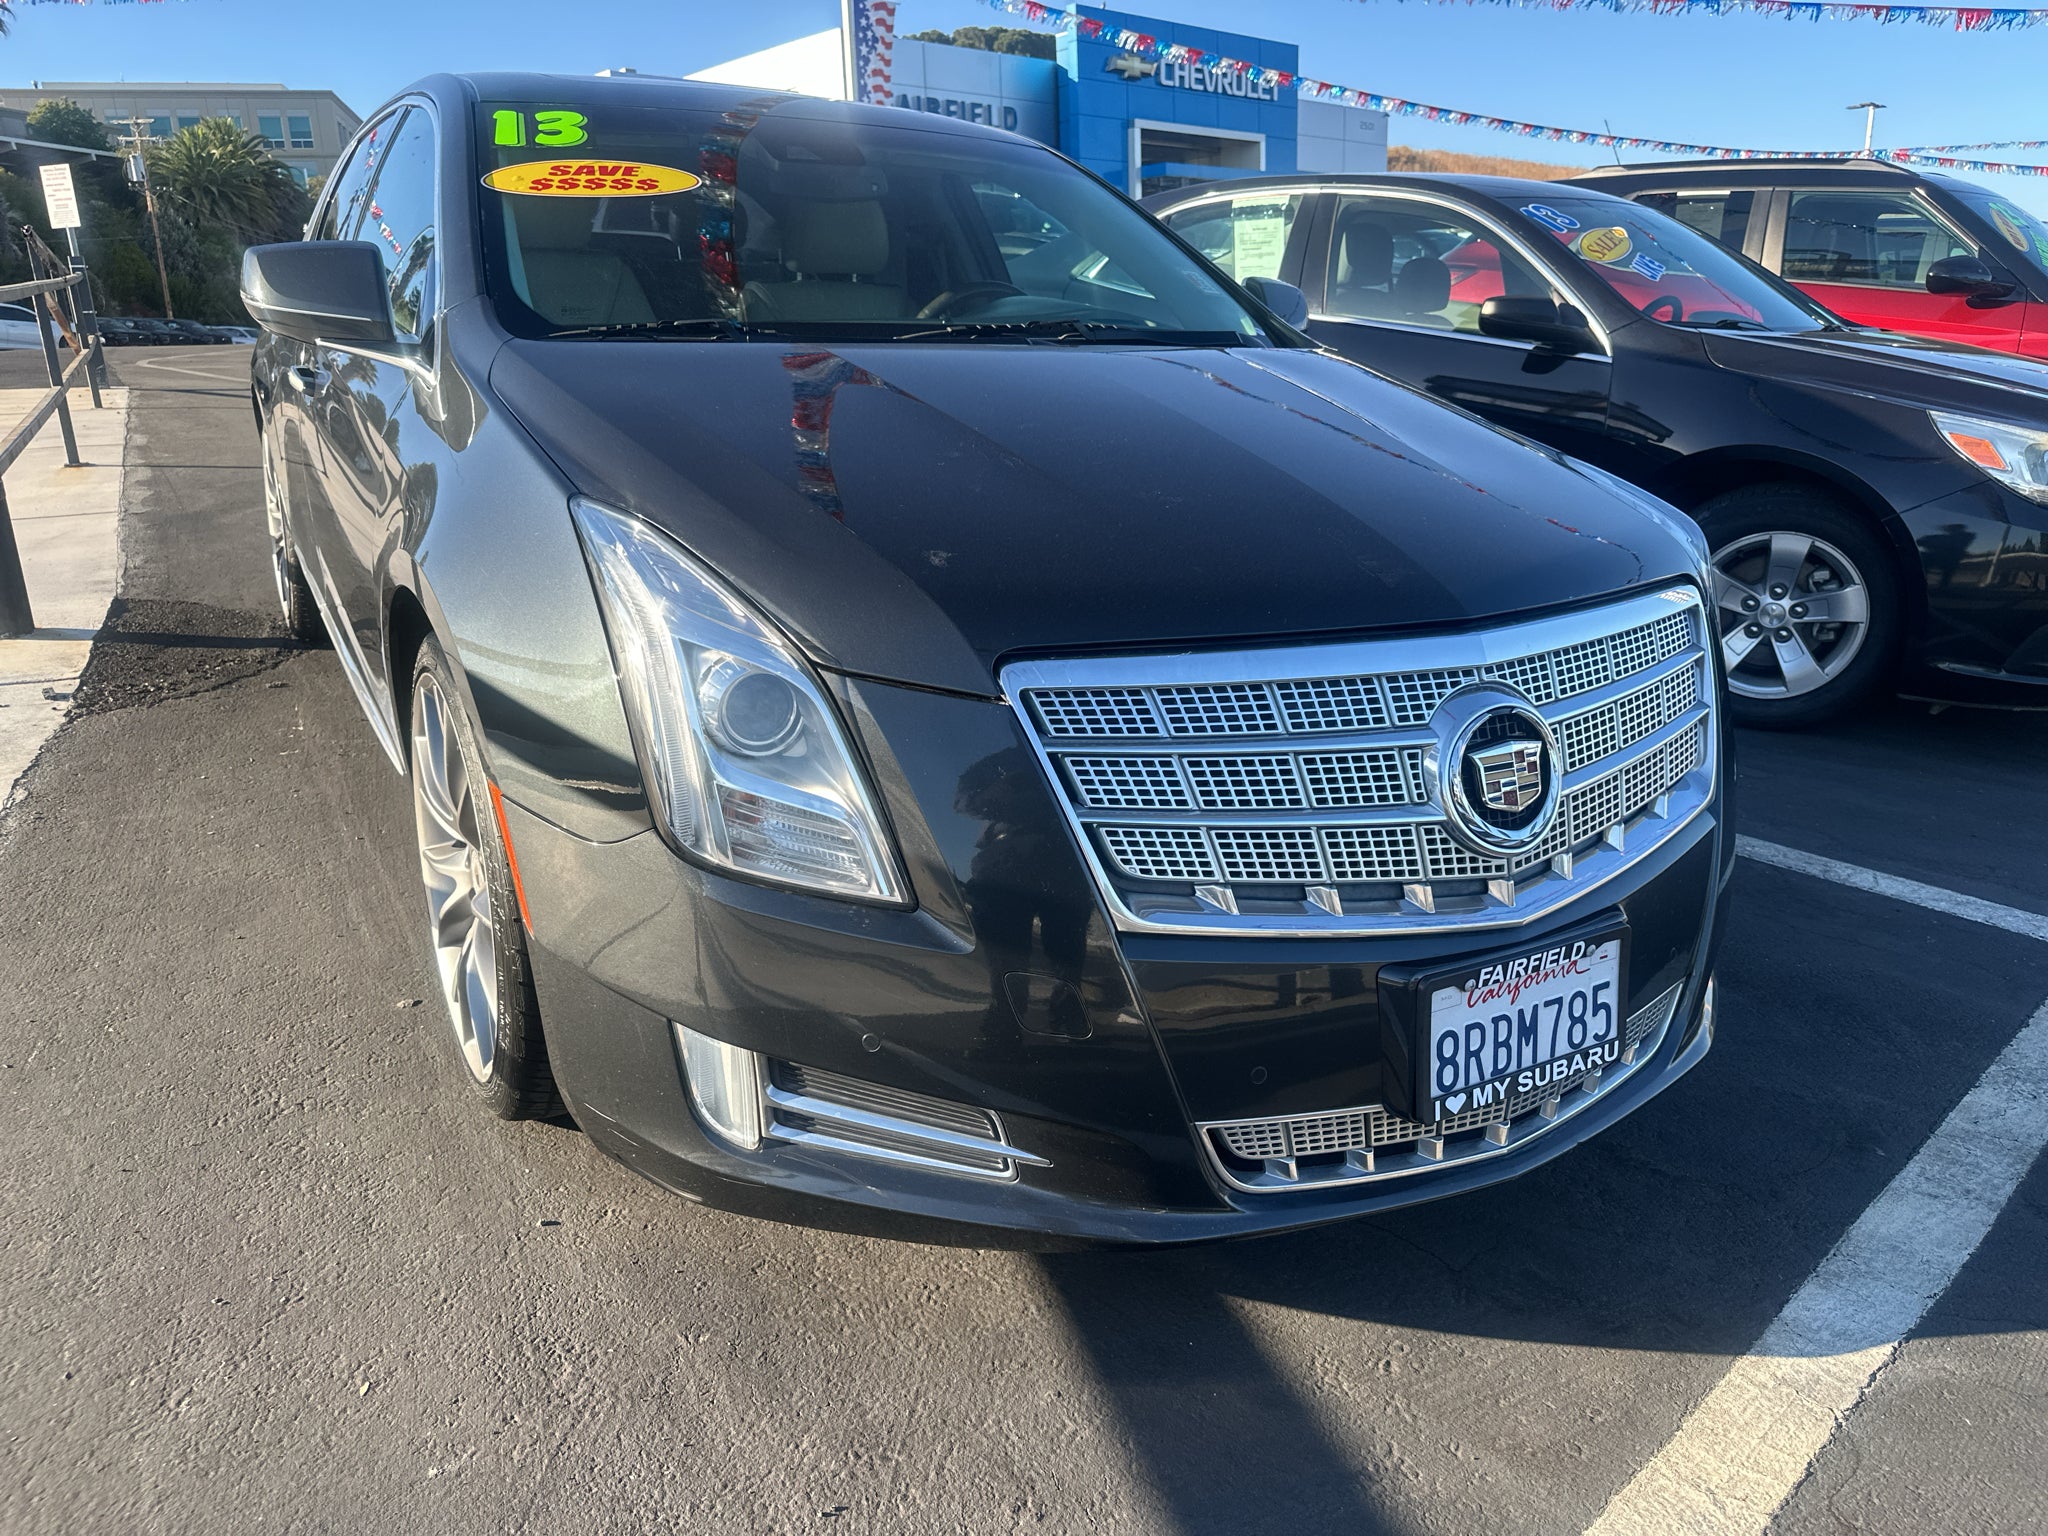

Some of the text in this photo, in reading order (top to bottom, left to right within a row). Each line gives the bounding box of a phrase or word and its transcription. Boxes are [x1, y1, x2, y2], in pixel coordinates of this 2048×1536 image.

[493, 110, 588, 147] 13
[895, 94, 1018, 131] AIRFIELD
[548, 165, 641, 177] SAVE
[1520, 203, 1581, 234] 13
[1467, 960, 1591, 1008] California
[1478, 941, 1585, 988] FAIRFIELD
[1436, 980, 1612, 1095] 8RBM785
[1472, 1078, 1512, 1109] MY
[1517, 1040, 1619, 1093] SUBARU
